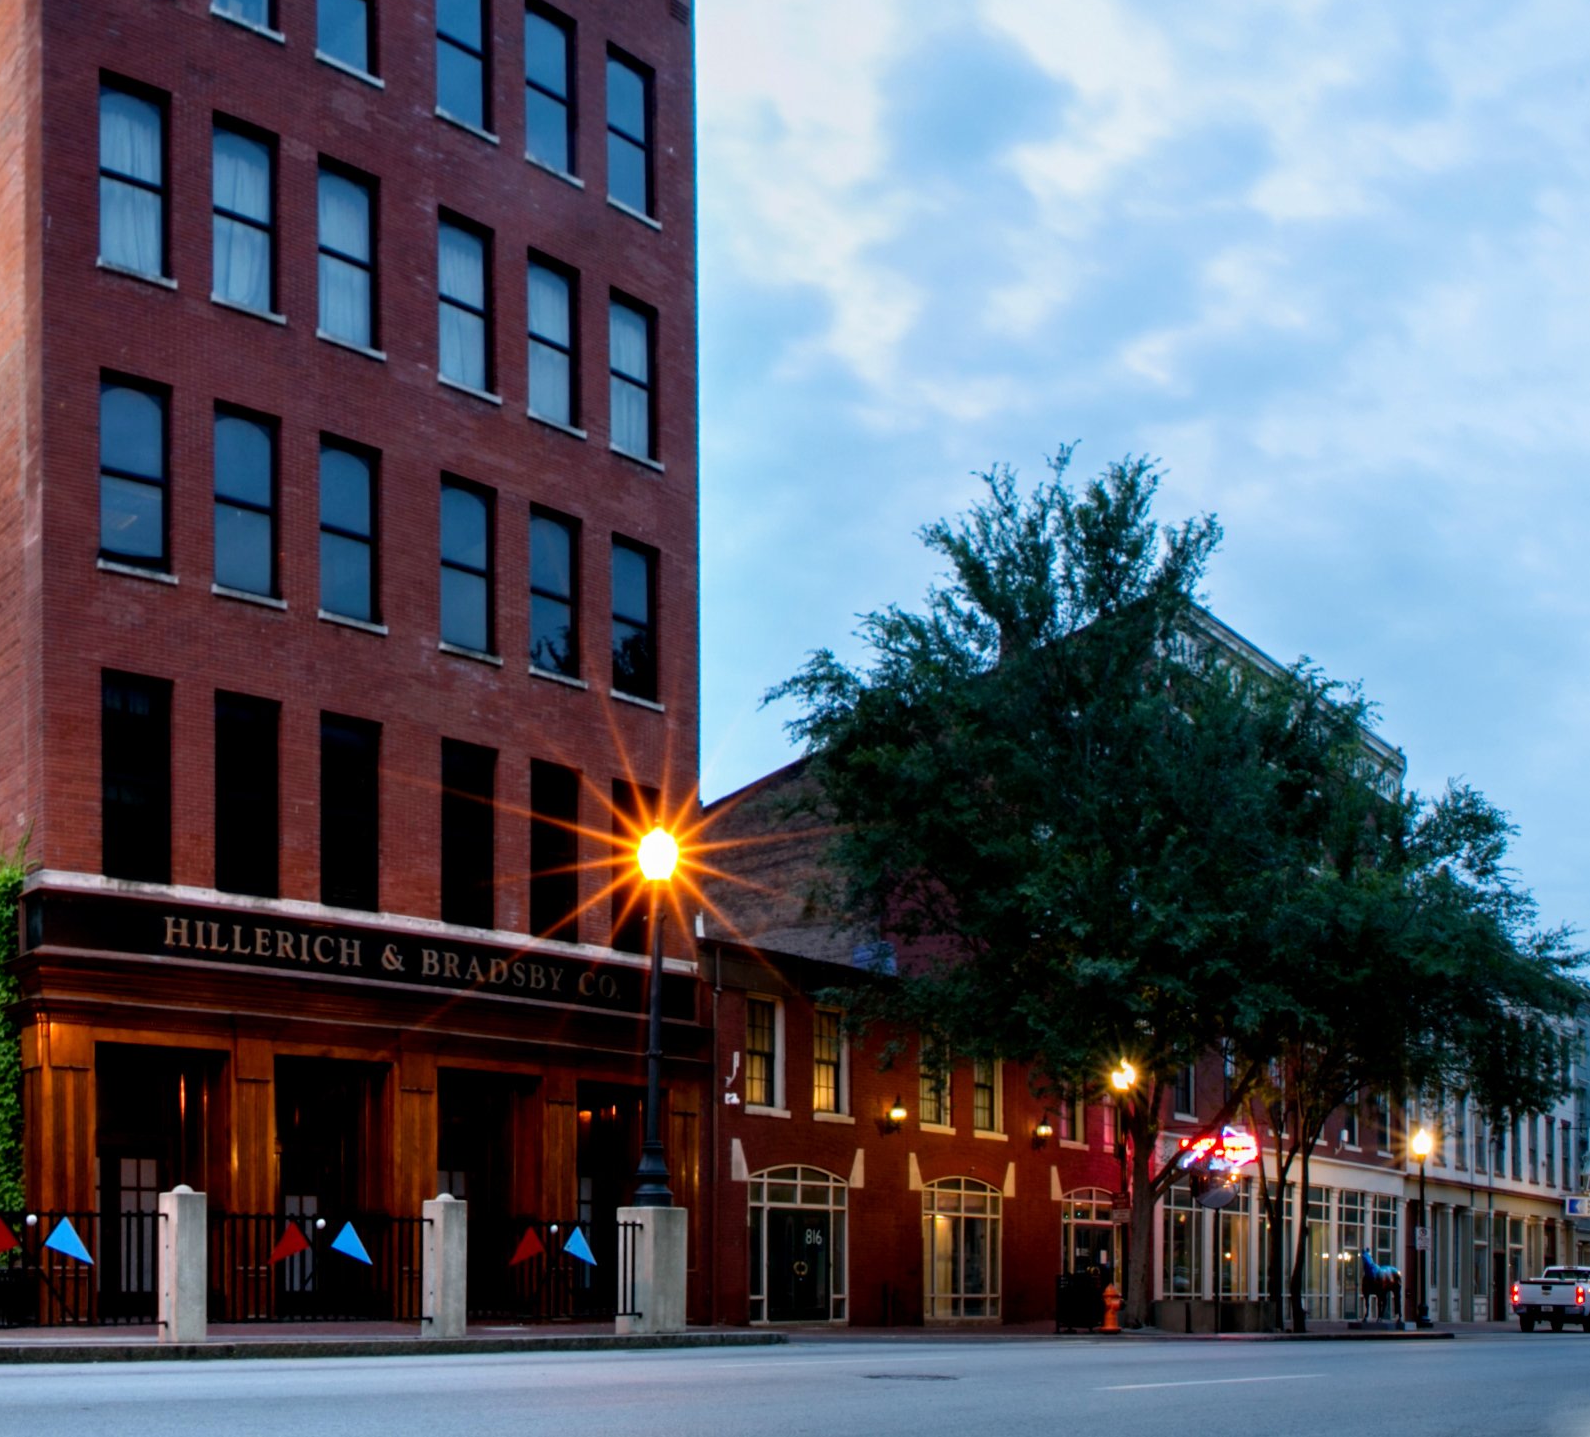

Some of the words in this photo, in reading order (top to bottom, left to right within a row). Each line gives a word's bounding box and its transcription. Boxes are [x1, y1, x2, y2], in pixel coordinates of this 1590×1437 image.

[164, 916, 362, 967] HILLERICH
[381, 943, 405, 972] &
[421, 948, 564, 992] BRADSBY
[578, 971, 621, 1000] CO.
[805, 1228, 822, 1245] 816
